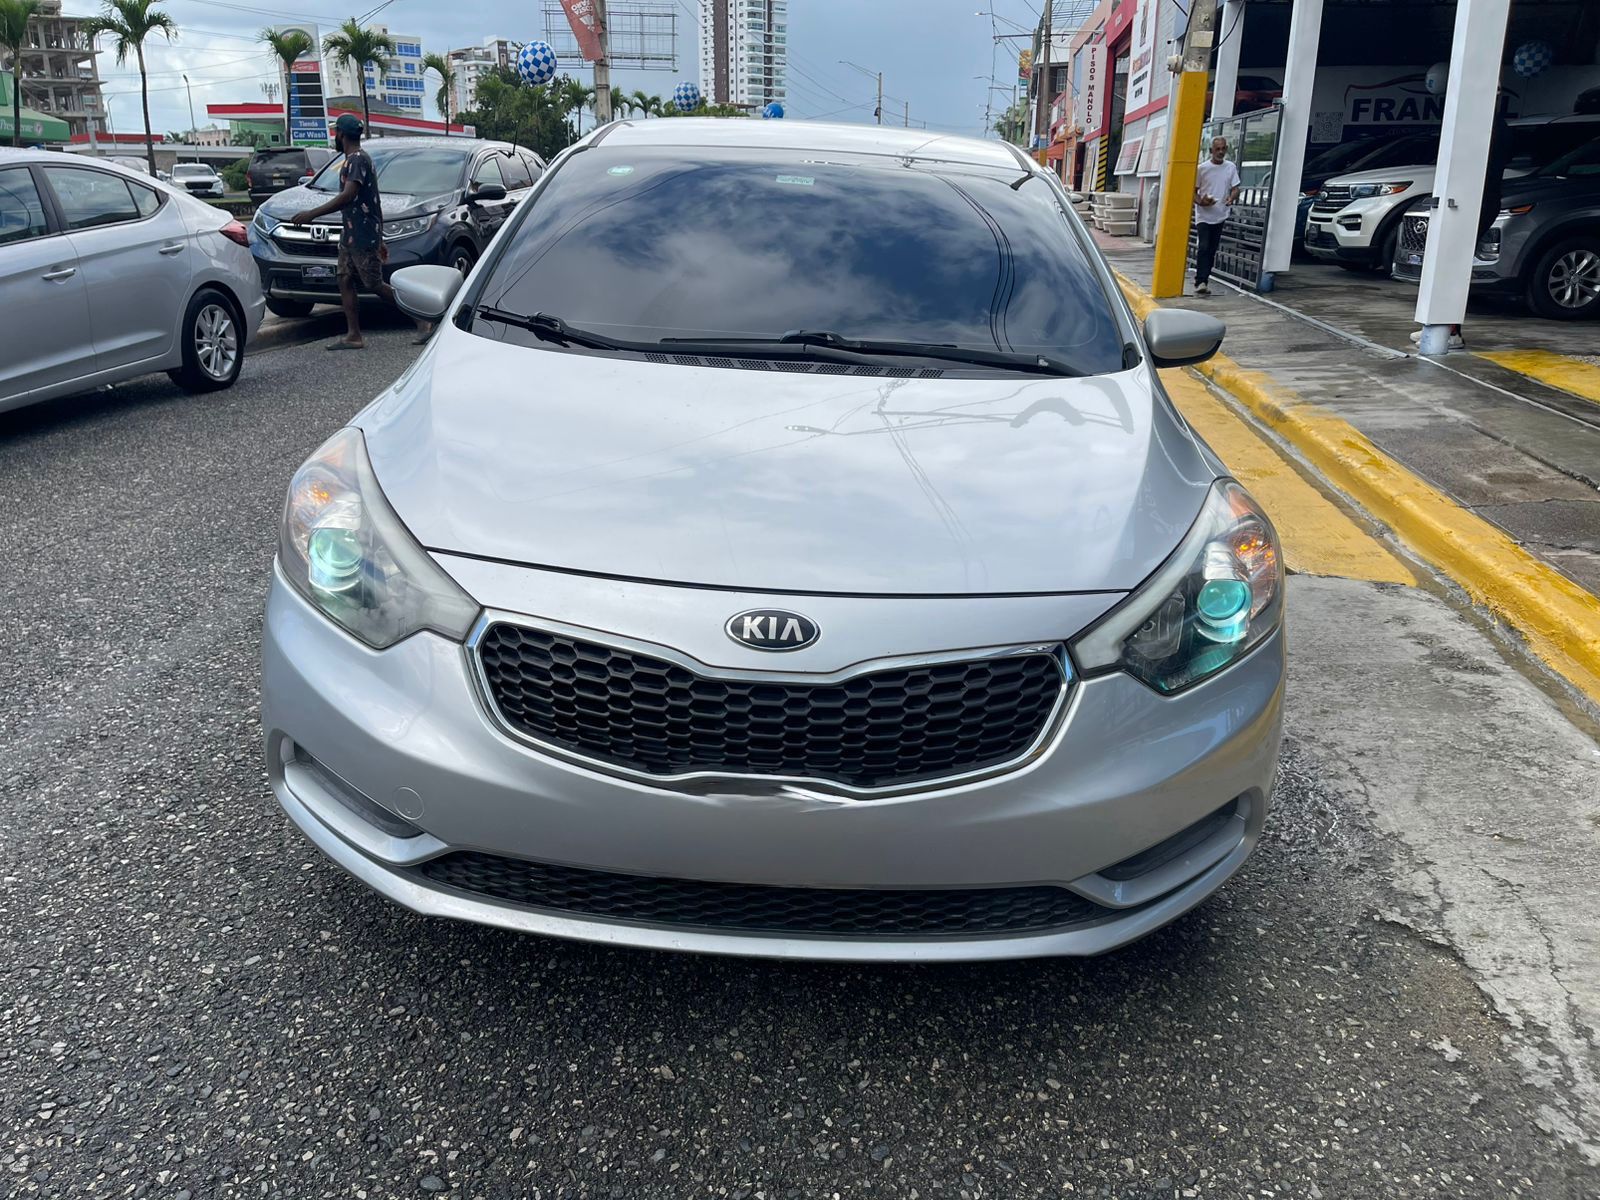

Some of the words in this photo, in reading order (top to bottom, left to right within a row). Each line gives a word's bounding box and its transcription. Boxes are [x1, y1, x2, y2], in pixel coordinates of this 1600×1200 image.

[1089, 47, 1097, 81] PISOS
[1086, 85, 1095, 124] MANOLO
[742, 615, 804, 642] KIA
